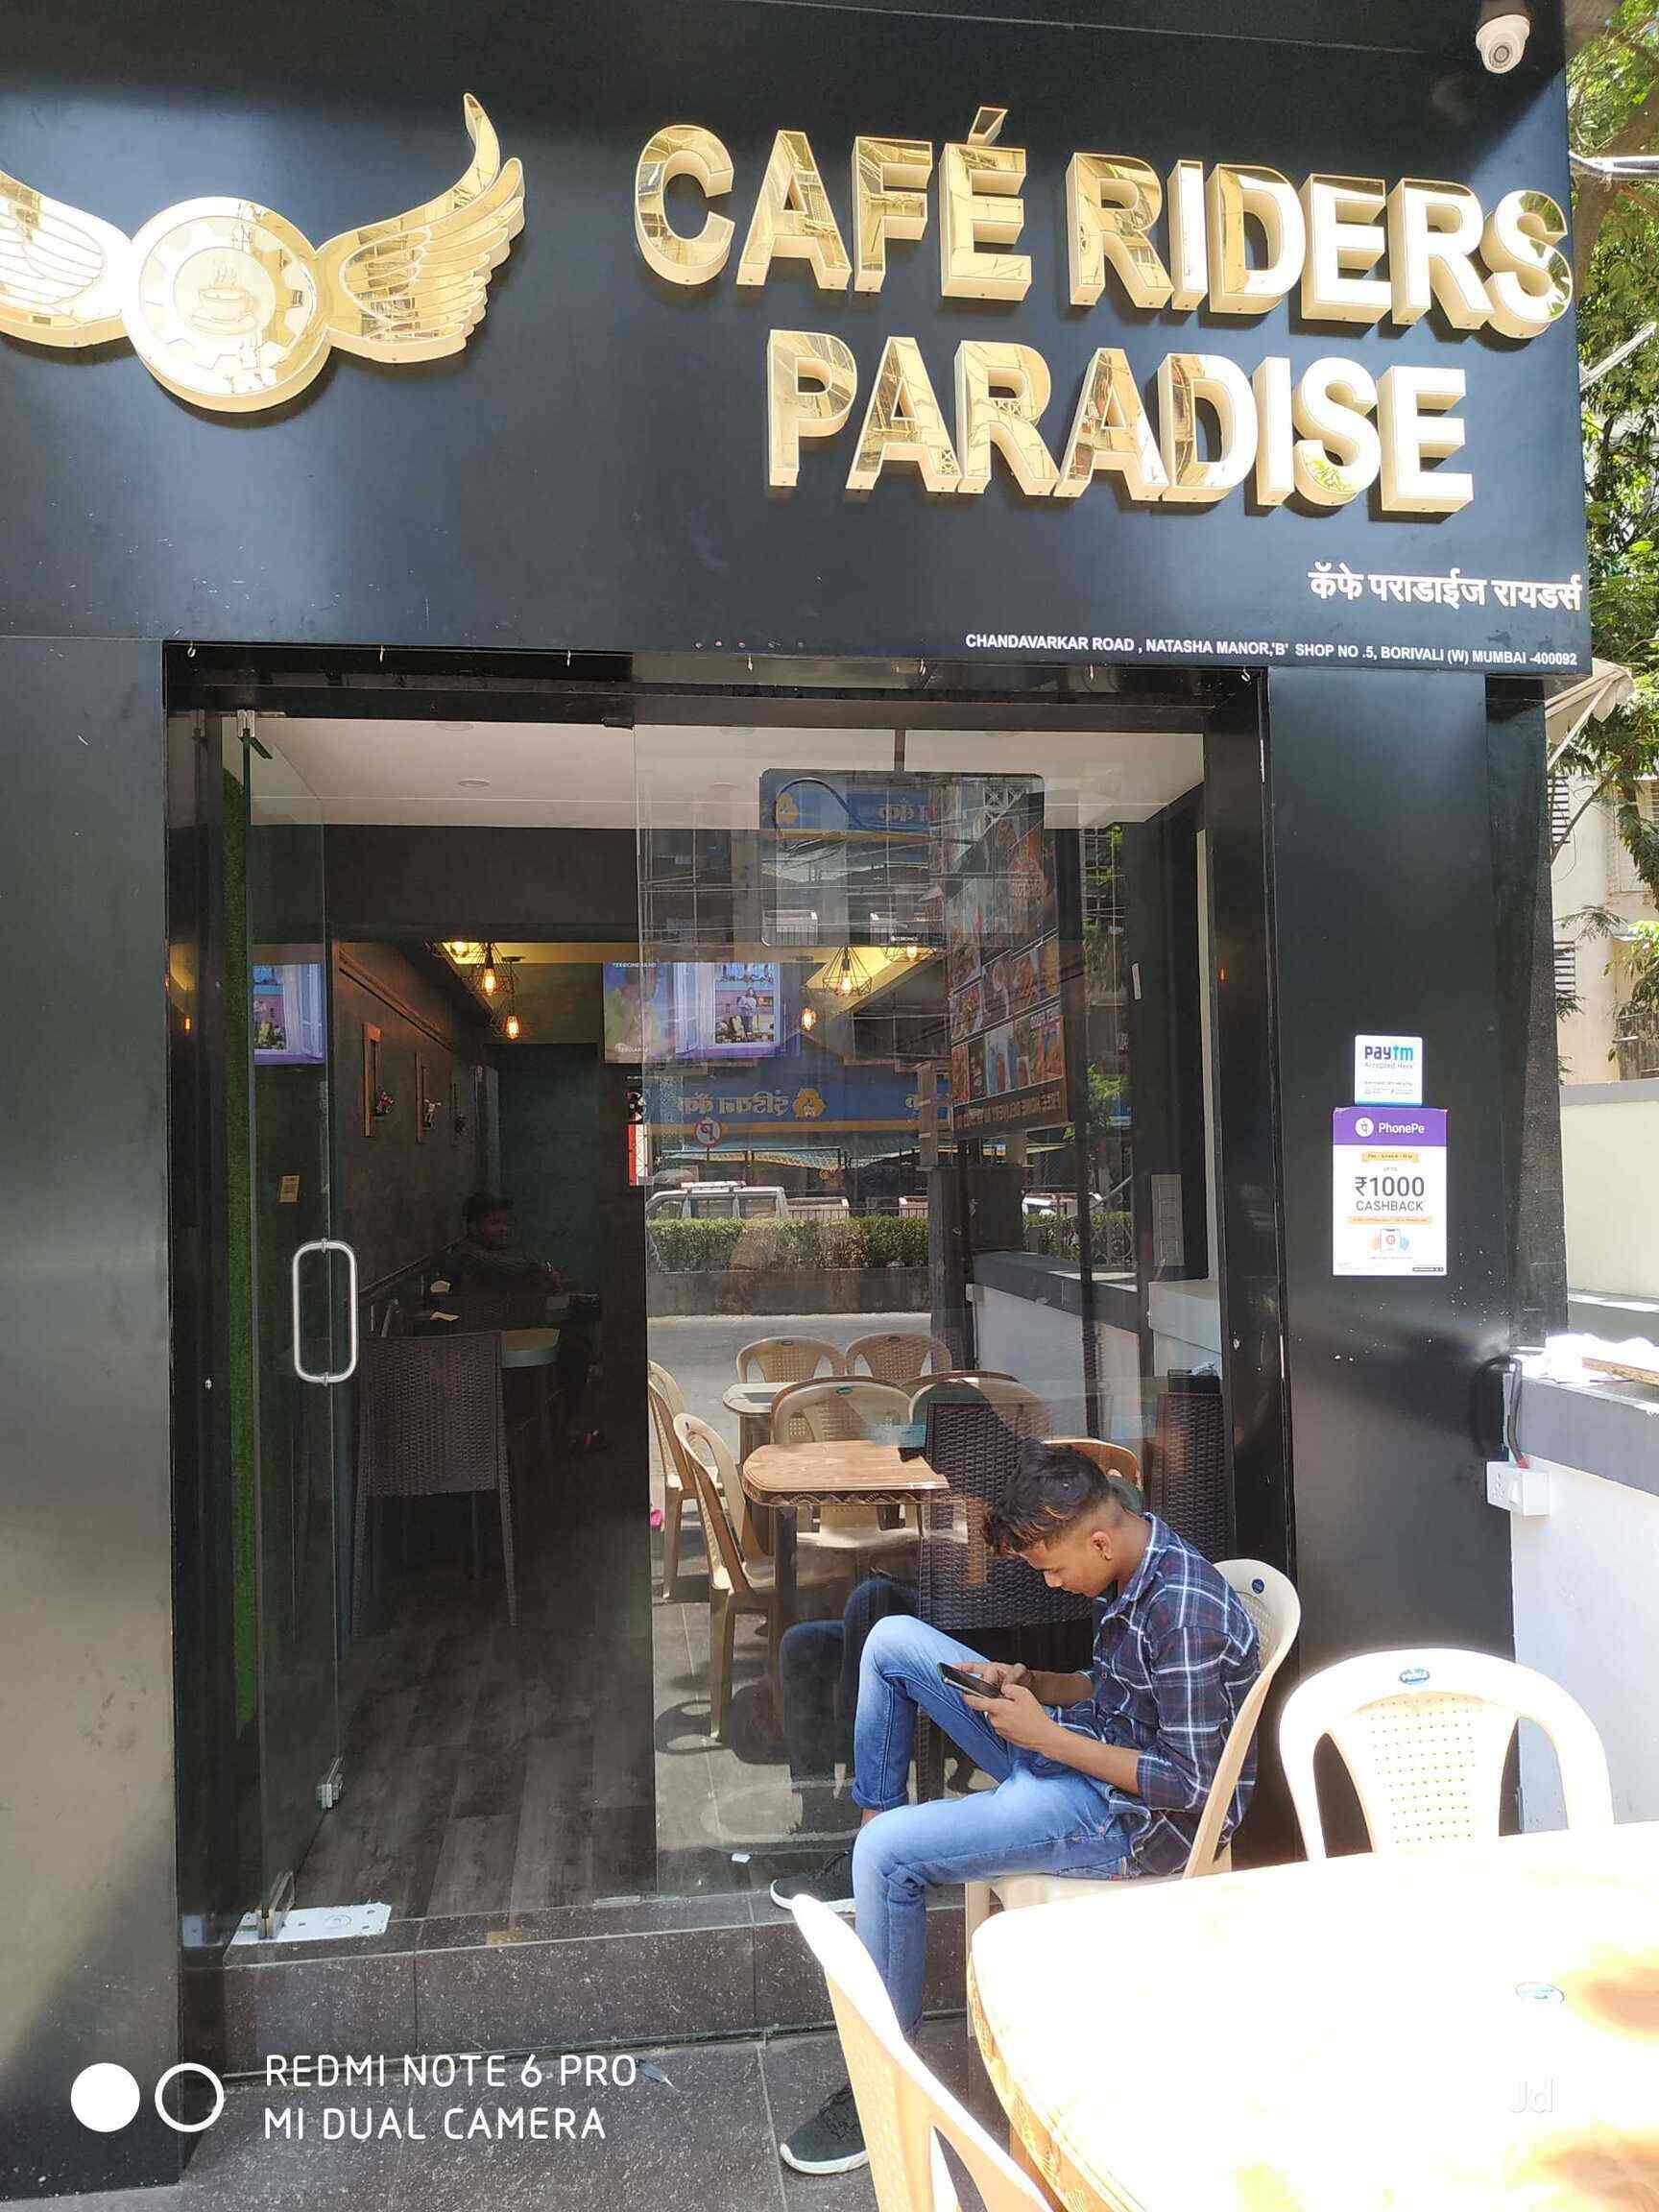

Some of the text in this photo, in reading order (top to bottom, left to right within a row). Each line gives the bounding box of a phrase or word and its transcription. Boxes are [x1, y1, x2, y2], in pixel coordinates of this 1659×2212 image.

[634, 107, 1574, 340] CAFÉ RIDERS
[767, 328, 1474, 514] PARADISE
[1491, 574, 1583, 611] रायडर्स
[965, 634, 1089, 651] CHANDAVARKAR
[1146, 638, 1213, 654] NATASHA
[1295, 643, 1334, 658] SHOP
[1381, 646, 1444, 661] BORIVALI
[1447, 649, 1470, 664] (W)
[1472, 649, 1527, 664] MUMBAI
[1378, 1122, 1426, 1134] PhonePe
[1355, 1176, 1425, 1196] ₹1000
[1356, 1200, 1424, 1212] CASHBACK
